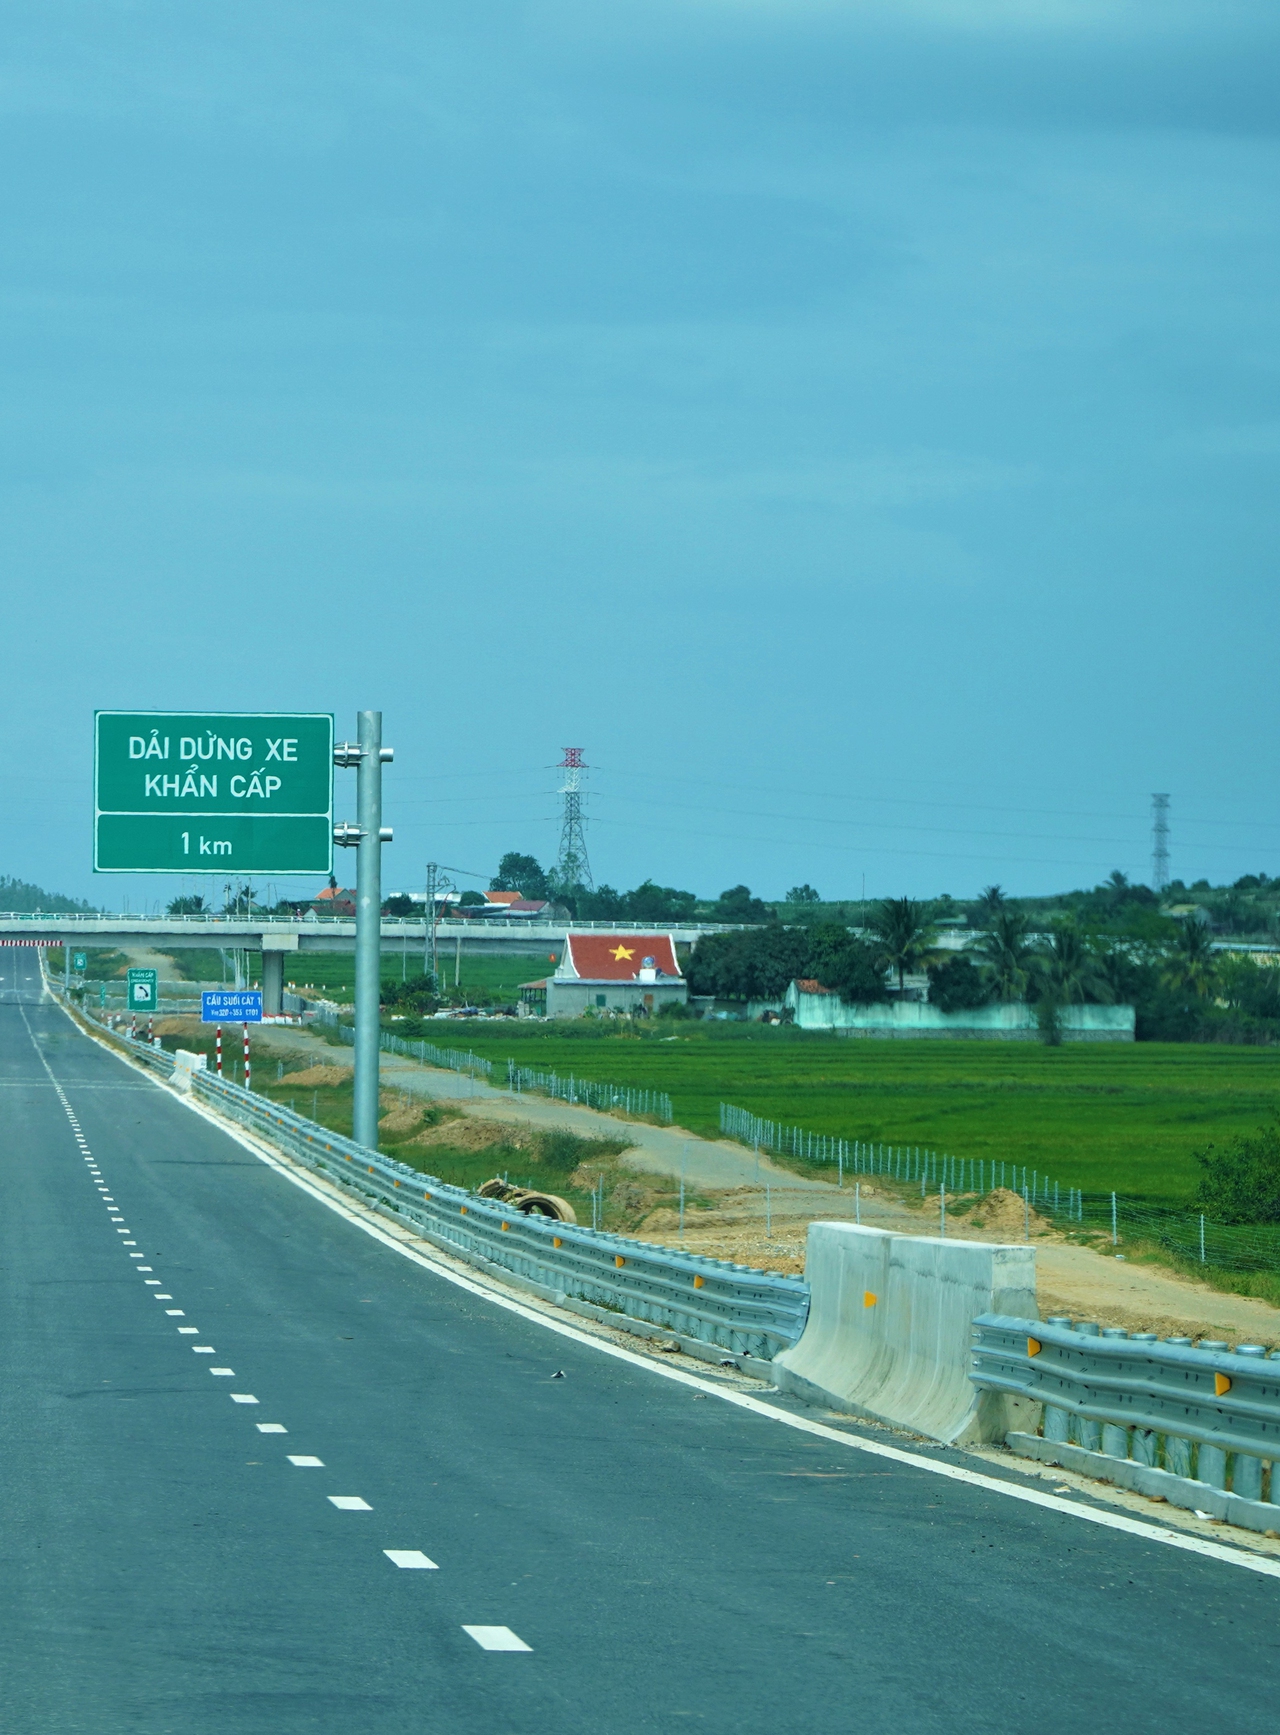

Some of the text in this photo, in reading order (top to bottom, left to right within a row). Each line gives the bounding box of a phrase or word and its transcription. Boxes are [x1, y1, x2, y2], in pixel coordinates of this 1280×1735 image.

[128, 728, 299, 762] DẢI DỪNG XE
[144, 763, 282, 798] KHẨN CẤP
[181, 831, 233, 856] 1 km
